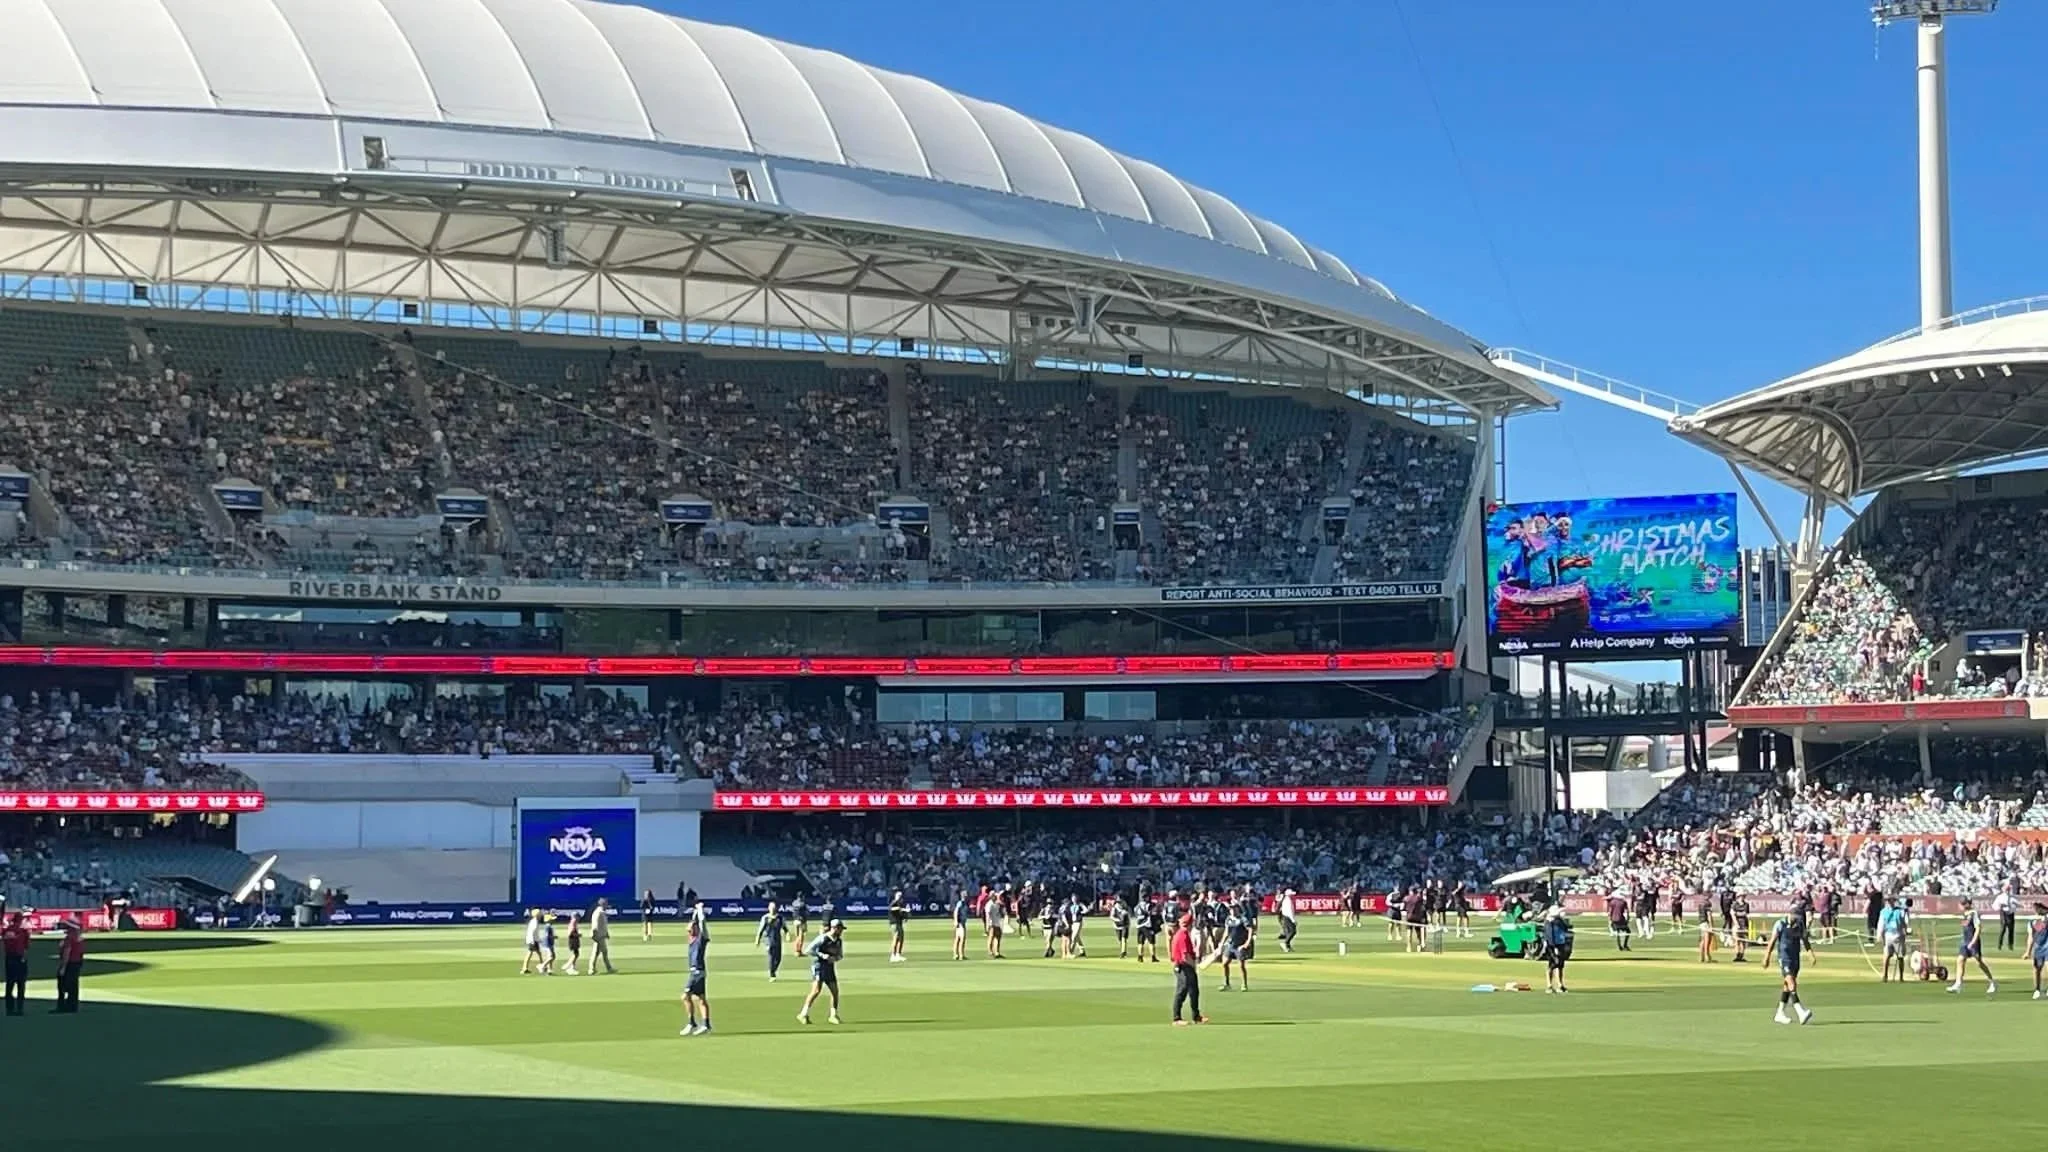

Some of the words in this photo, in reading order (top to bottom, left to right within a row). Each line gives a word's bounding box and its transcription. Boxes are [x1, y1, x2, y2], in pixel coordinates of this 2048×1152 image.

[1590, 516, 1730, 555] CHRISTMAS
[1620, 543, 1706, 575] MATCH
[289, 581, 421, 599] RIVERBANK
[430, 585, 502, 601] STAND
[1166, 589, 1205, 600] REPORT
[1207, 588, 1272, 600] ANTI-SOCIAL
[1275, 587, 1333, 598] BEHAVIOUR
[1342, 586, 1367, 596] TEXT
[1369, 585, 1397, 595] 0400
[1399, 584, 1422, 595] TELL
[1424, 584, 1438, 594] US
[1570, 638, 1580, 648] A
[1580, 637, 1604, 650] Help
[1605, 636, 1656, 649] Company
[549, 837, 606, 852] NRMA
